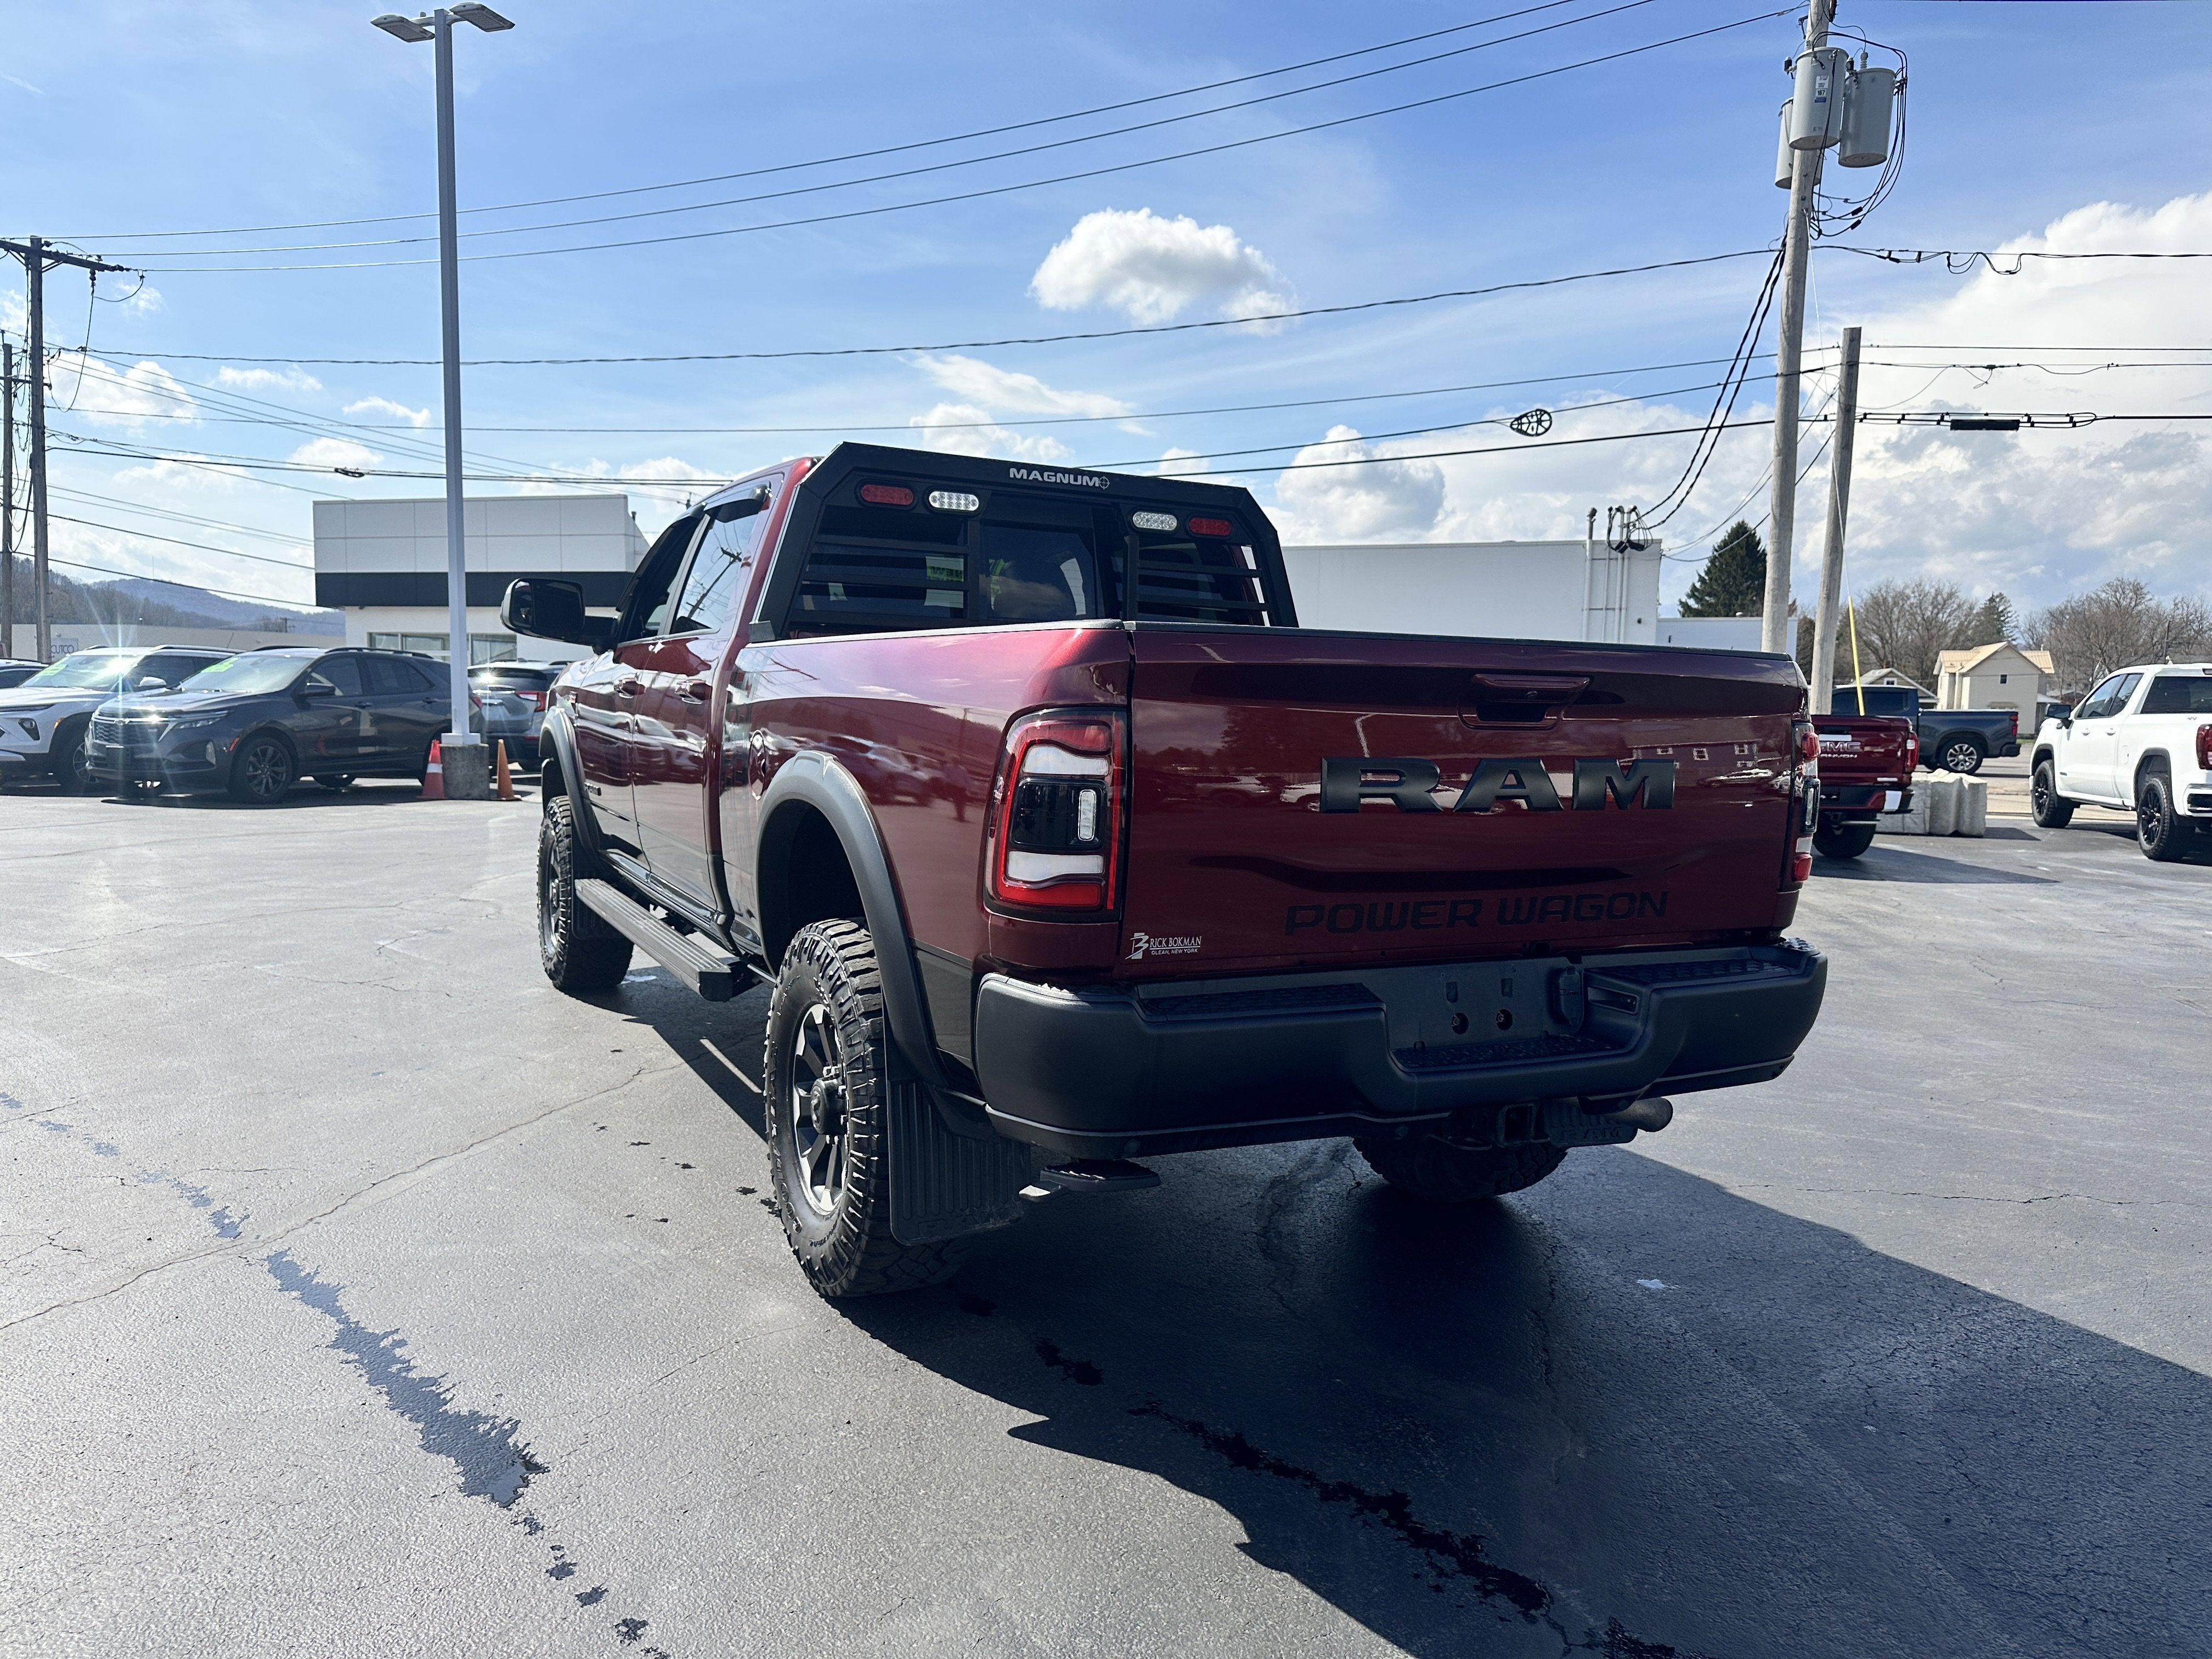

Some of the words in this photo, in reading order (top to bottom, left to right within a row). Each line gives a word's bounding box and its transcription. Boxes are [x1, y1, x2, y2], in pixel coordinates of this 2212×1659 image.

[1009, 467, 1099, 487] MAGNUM
[51, 644, 74, 653] CUTCO
[1319, 757, 1675, 813] RAM
[1284, 899, 1482, 935] POWER
[1497, 891, 1668, 926] WAGON
[1149, 938, 1167, 948] RICK
[1169, 936, 1201, 946] BOKMAN
